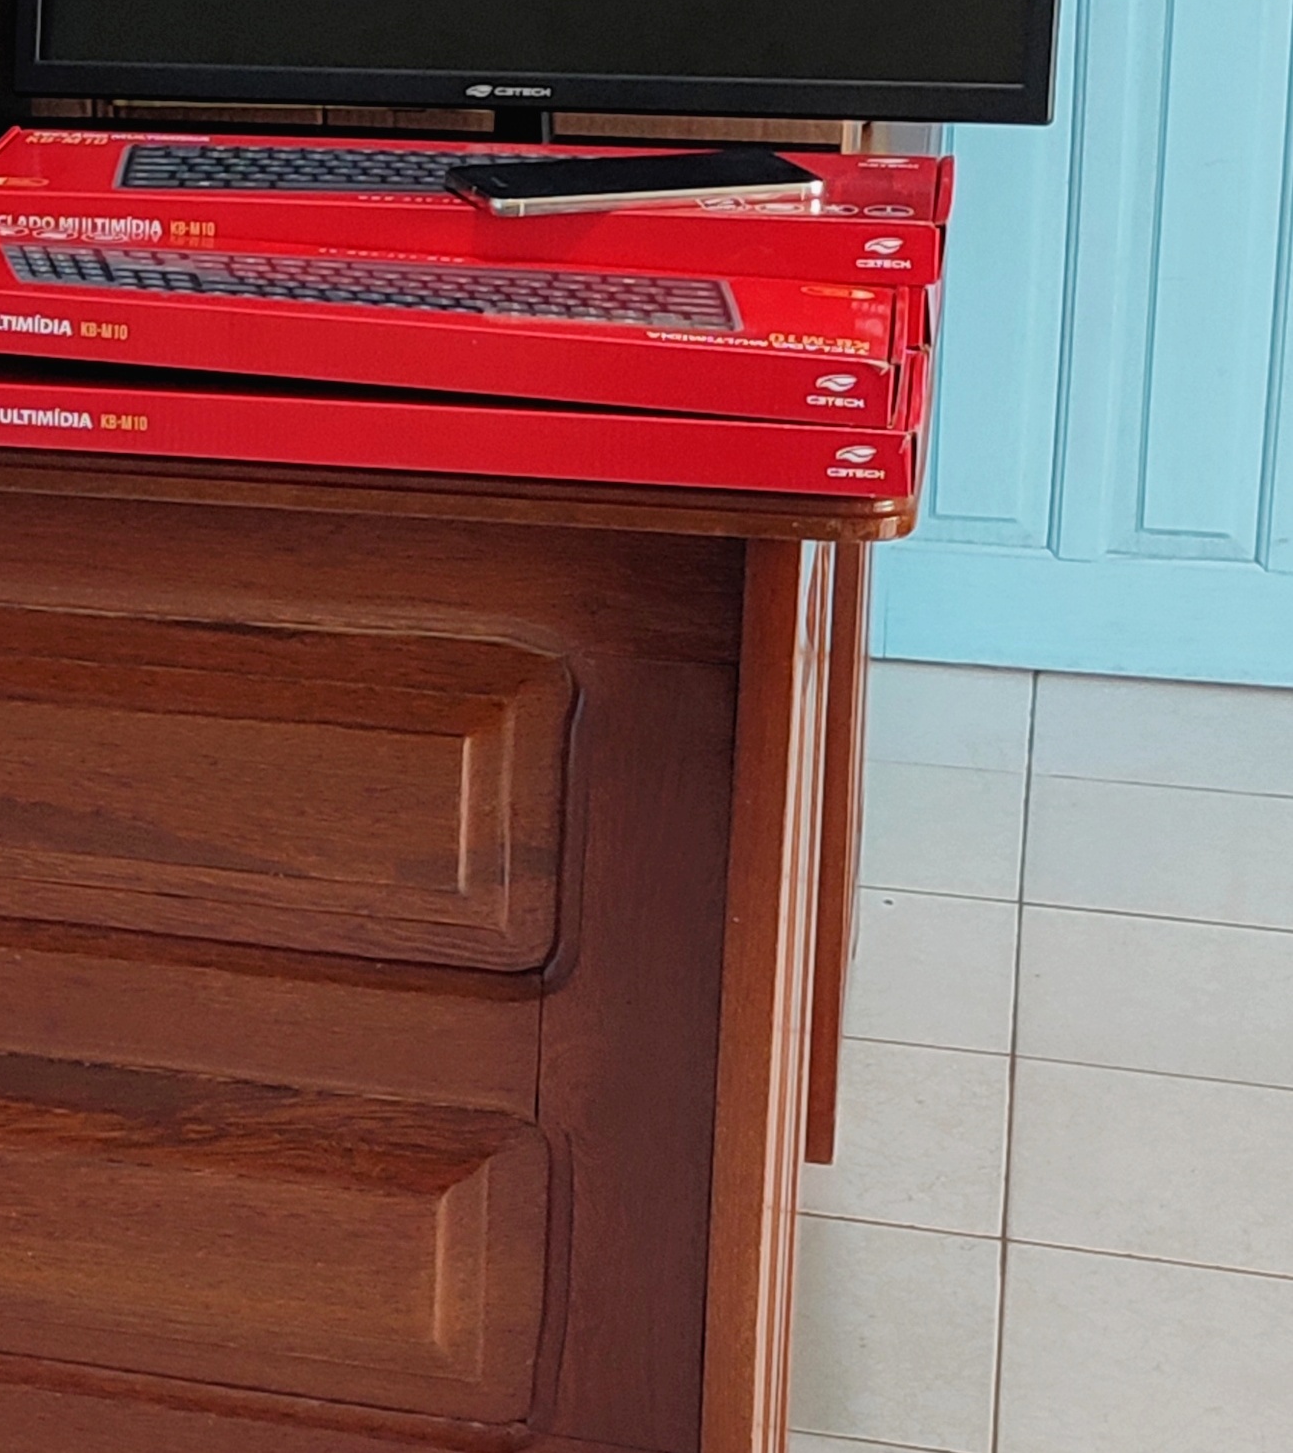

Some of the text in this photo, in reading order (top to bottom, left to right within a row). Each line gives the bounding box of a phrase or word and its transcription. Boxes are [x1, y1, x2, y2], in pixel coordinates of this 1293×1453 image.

[58, 215, 164, 237] MULTIMÍDIA
[169, 221, 216, 237] KB-M10
[79, 321, 129, 341] KB-M10
[99, 413, 148, 432] KB-M10
